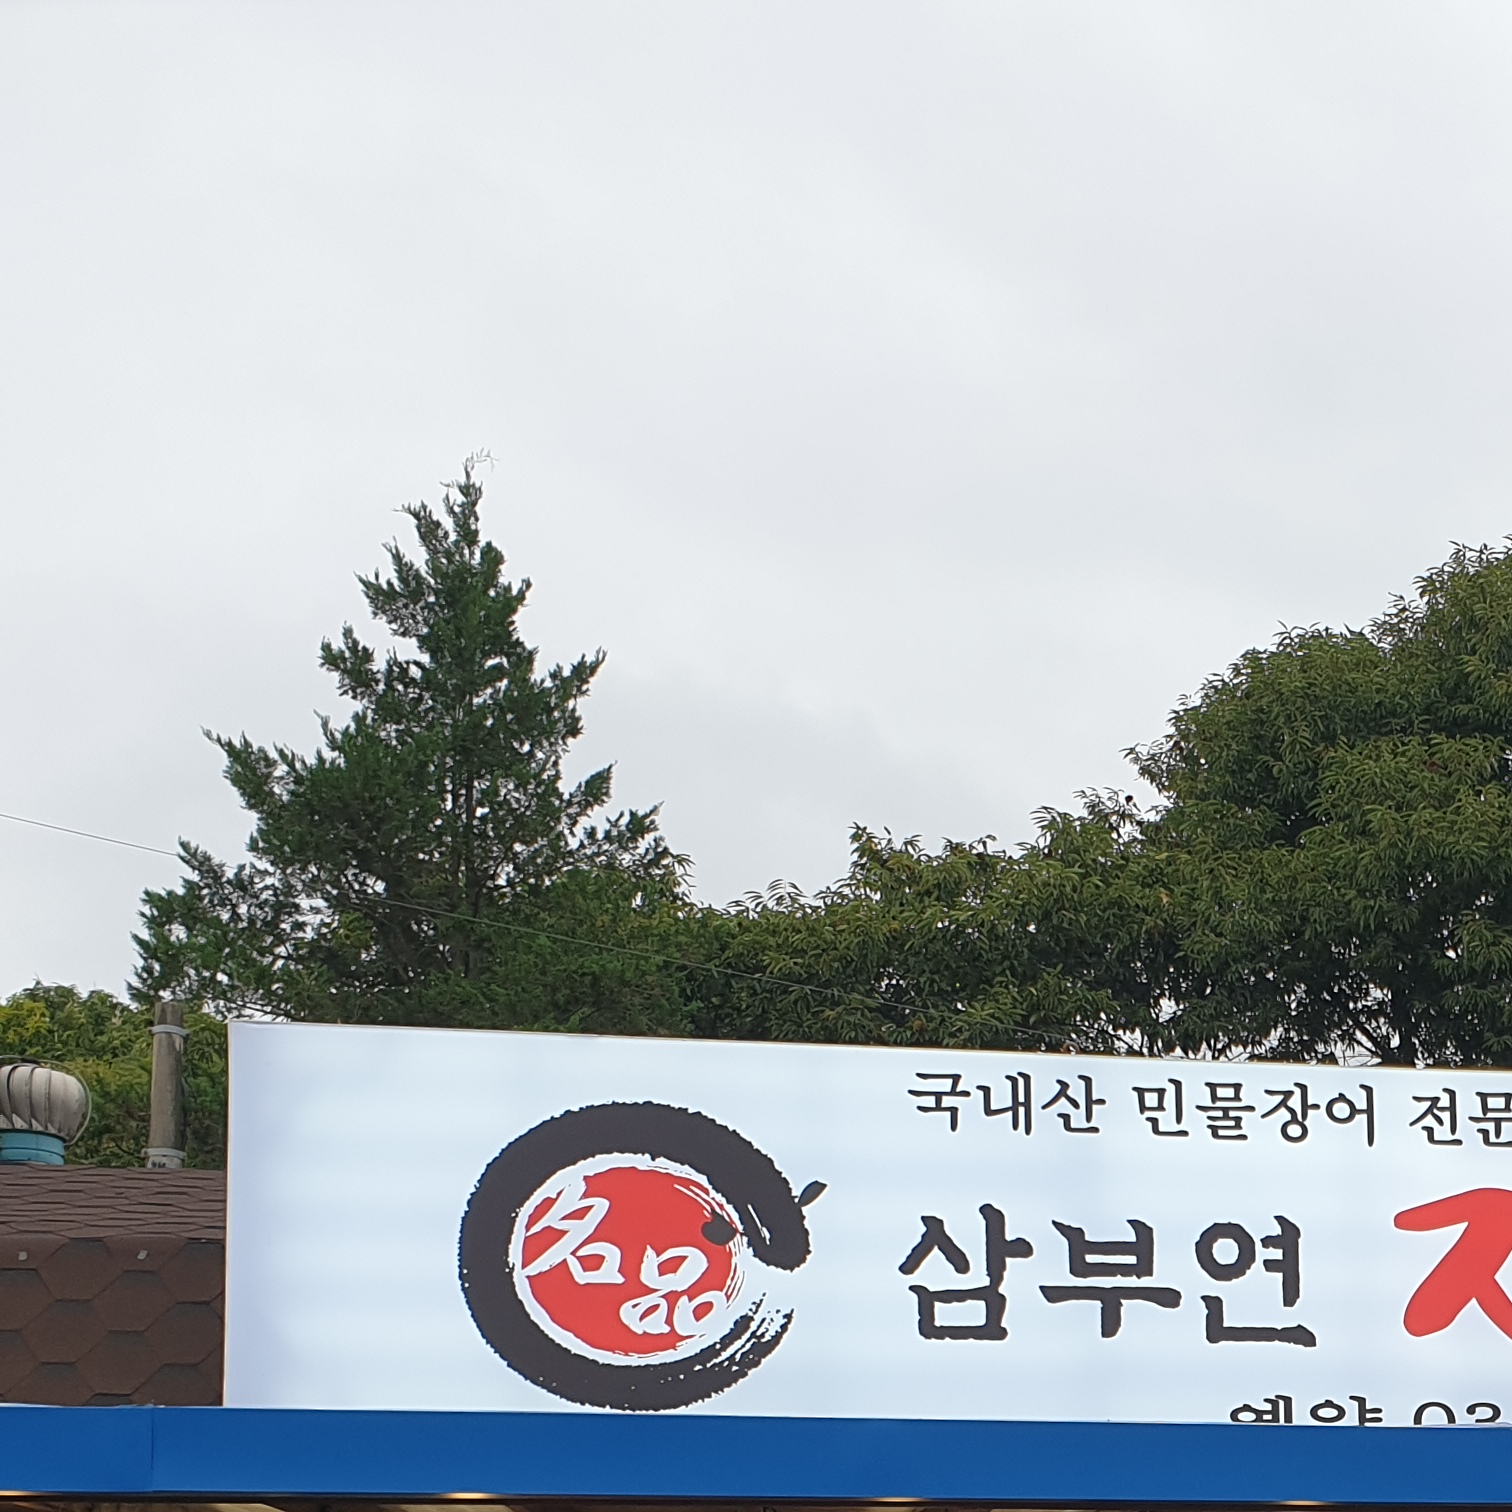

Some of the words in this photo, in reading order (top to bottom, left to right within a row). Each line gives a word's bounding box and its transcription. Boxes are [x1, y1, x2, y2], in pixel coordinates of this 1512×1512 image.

[907, 1071, 1107, 1136] 국내산
[1131, 1078, 1376, 1148] 민물장어
[898, 1203, 1317, 1348] 삼부연
